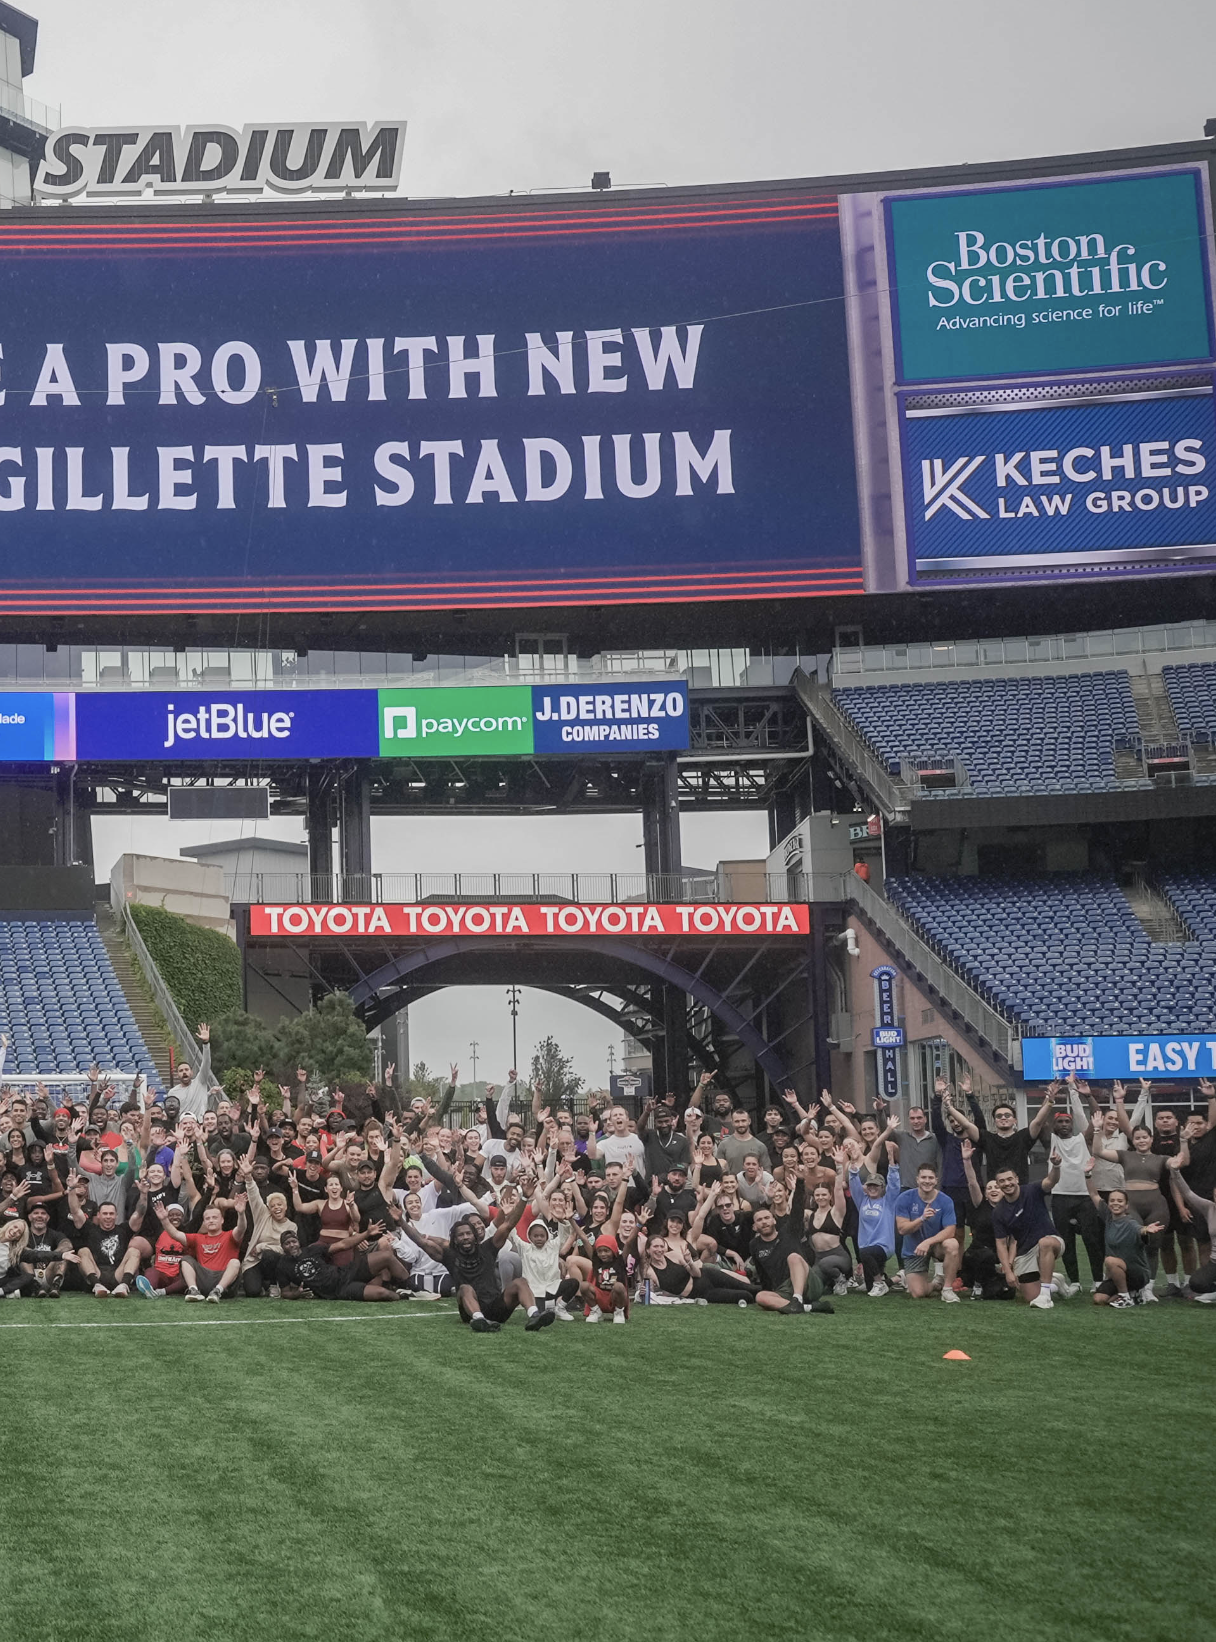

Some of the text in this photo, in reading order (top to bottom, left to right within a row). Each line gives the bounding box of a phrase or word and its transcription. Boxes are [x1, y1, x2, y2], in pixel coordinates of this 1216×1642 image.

[41, 126, 400, 187] STADIUM
[954, 230, 1109, 271] Boston
[926, 243, 1168, 308] Scientific
[936, 312, 1026, 331] Advancing
[1031, 305, 1092, 324] science
[1098, 303, 1123, 318] for
[30, 344, 81, 405] A
[106, 341, 261, 405] PRO
[287, 335, 497, 402] WITH
[525, 325, 704, 395] NEW
[374, 430, 735, 506] STADIUM
[994, 438, 1206, 488] KECHES
[997, 485, 1210, 519] LAW GROUP
[164, 704, 294, 748] jetBlue
[421, 716, 527, 738] paycom
[561, 723, 660, 742] COMPANIES
[264, 906, 799, 933] TOYOTA TOYOTA TOYOTA TOYOTA
[881, 980, 892, 1024] BEER
[876, 1036, 901, 1044] LIGHT
[879, 1030, 898, 1038] BUD
[1055, 1044, 1092, 1058] BUD
[885, 1049, 896, 1093] HALL
[1052, 1057, 1094, 1071] LIGHT
[1128, 1041, 1201, 1072] EASY
